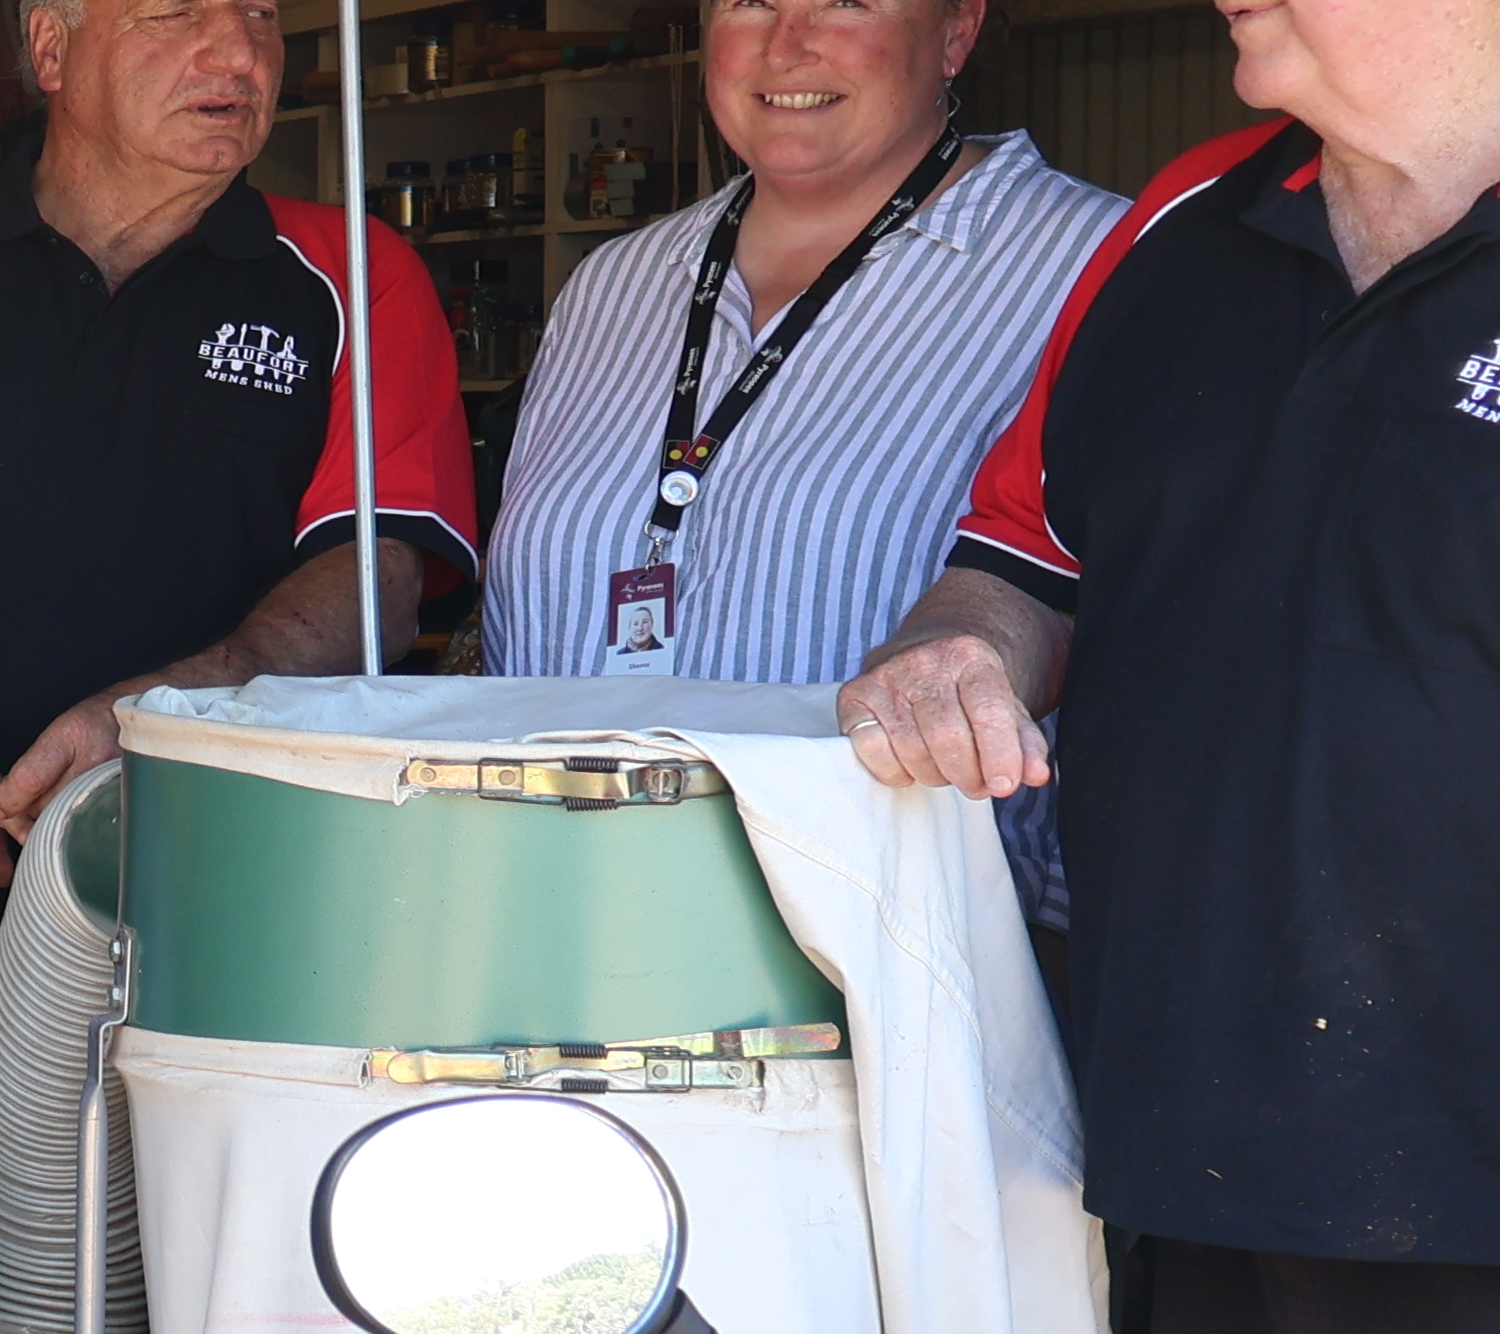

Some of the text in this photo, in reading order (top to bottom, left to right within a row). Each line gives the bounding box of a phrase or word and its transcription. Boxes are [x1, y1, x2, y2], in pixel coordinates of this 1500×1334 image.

[198, 343, 309, 376] BEAUFORT
[204, 369, 293, 395] MENS SHED
